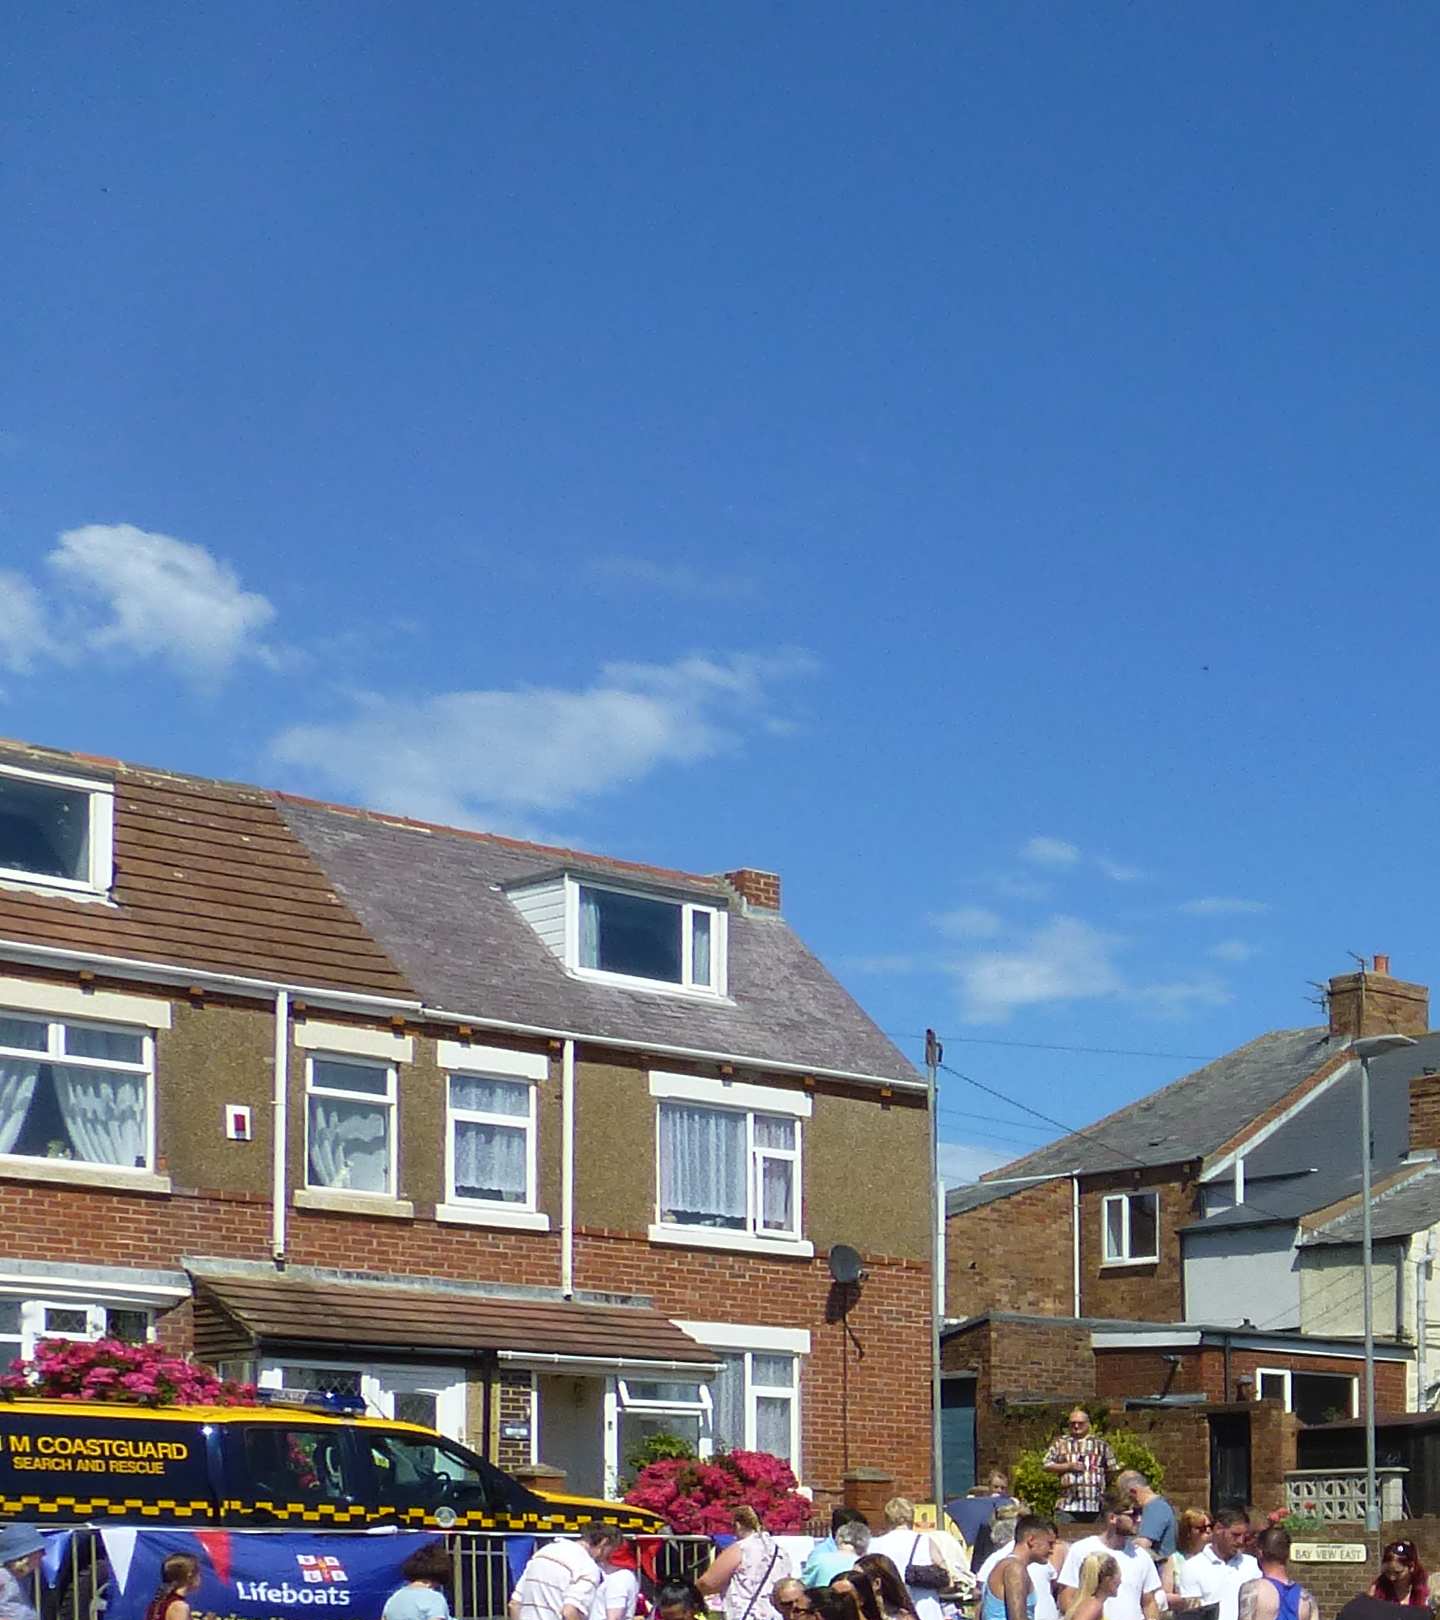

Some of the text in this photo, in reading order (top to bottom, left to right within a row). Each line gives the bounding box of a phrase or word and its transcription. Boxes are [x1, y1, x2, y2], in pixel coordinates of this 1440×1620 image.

[36, 1436, 188, 1461] COASTGUARD
[12, 1456, 166, 1475] SEARCH AND RESCUE
[236, 1581, 351, 1606] Lifeboats
